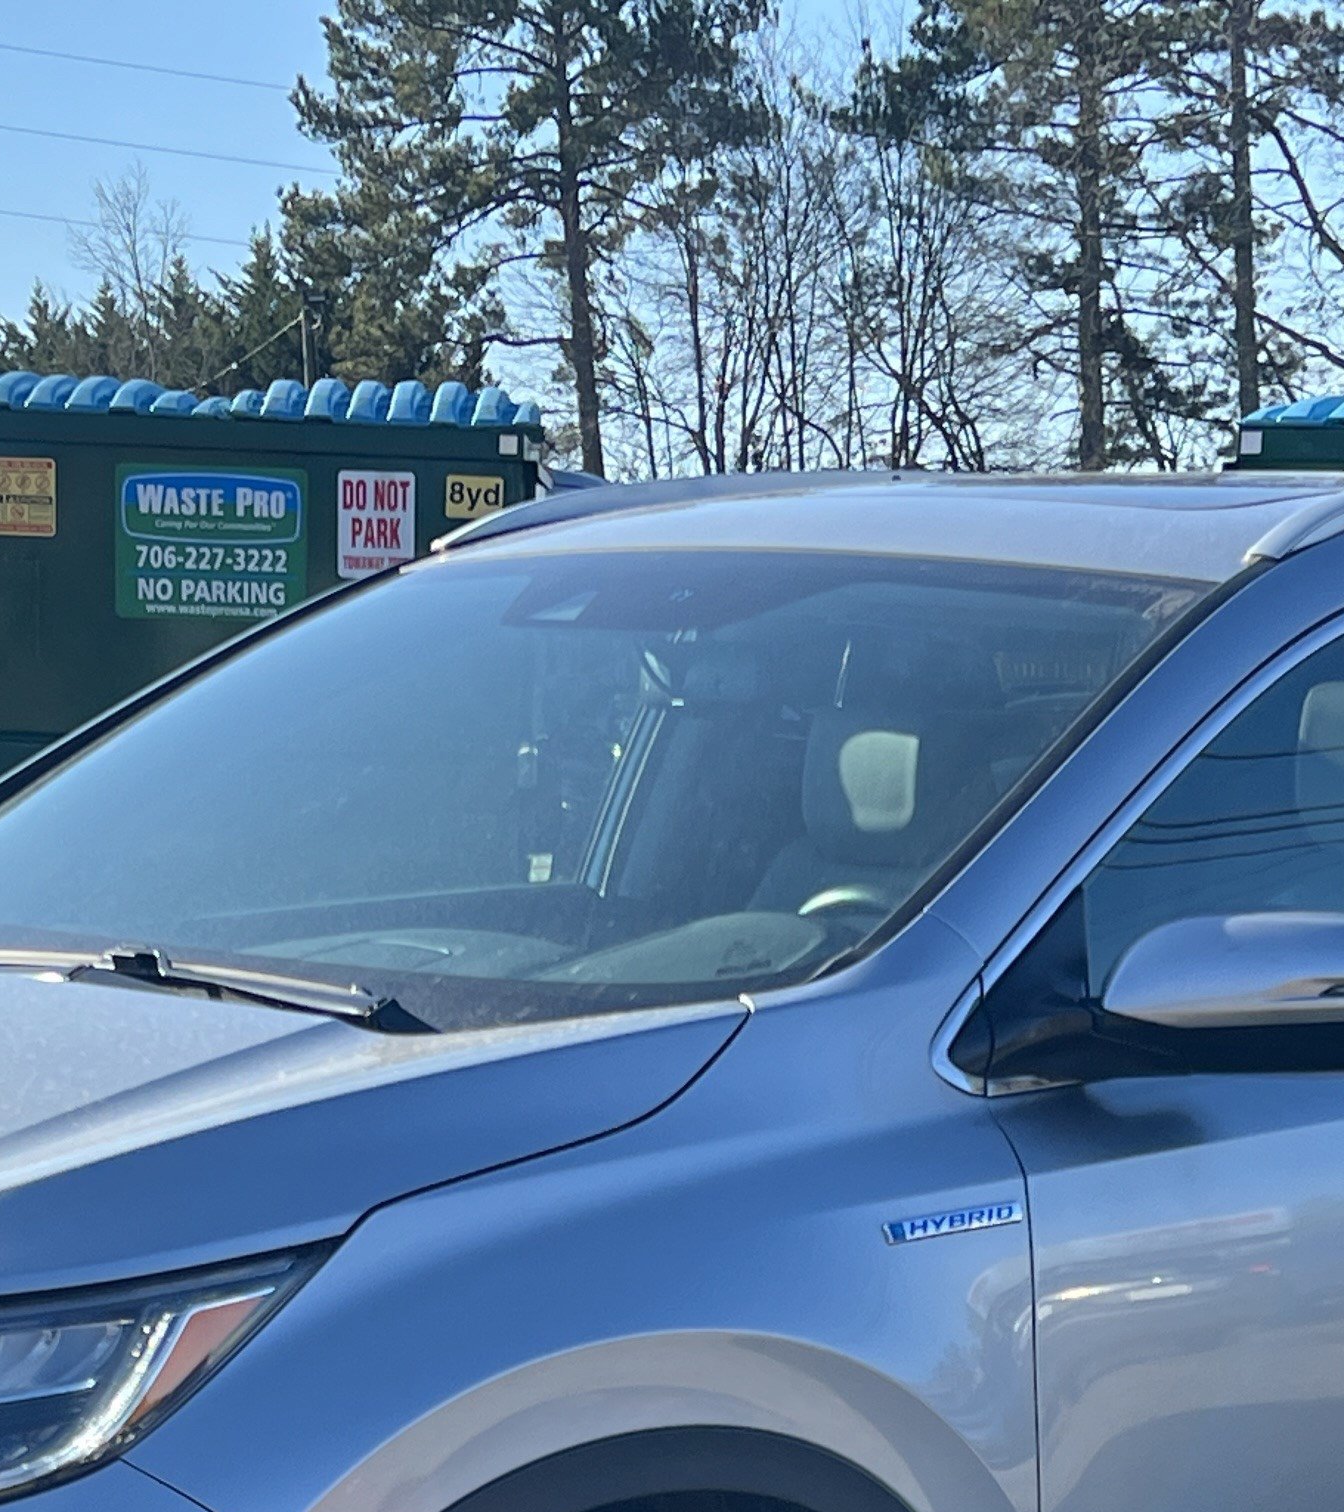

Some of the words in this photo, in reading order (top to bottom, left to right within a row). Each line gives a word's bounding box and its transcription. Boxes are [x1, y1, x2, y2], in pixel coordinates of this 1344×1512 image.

[136, 483, 224, 516] WASTE
[236, 487, 286, 519] PRO
[342, 479, 367, 510] DO
[374, 480, 410, 513] NOT
[449, 481, 500, 511] 8yd
[351, 517, 401, 549] PARK
[135, 544, 288, 574] 706-227-3222
[137, 577, 174, 601] NO
[181, 579, 286, 606] PARKING
[909, 1205, 1013, 1237] HYBRID
